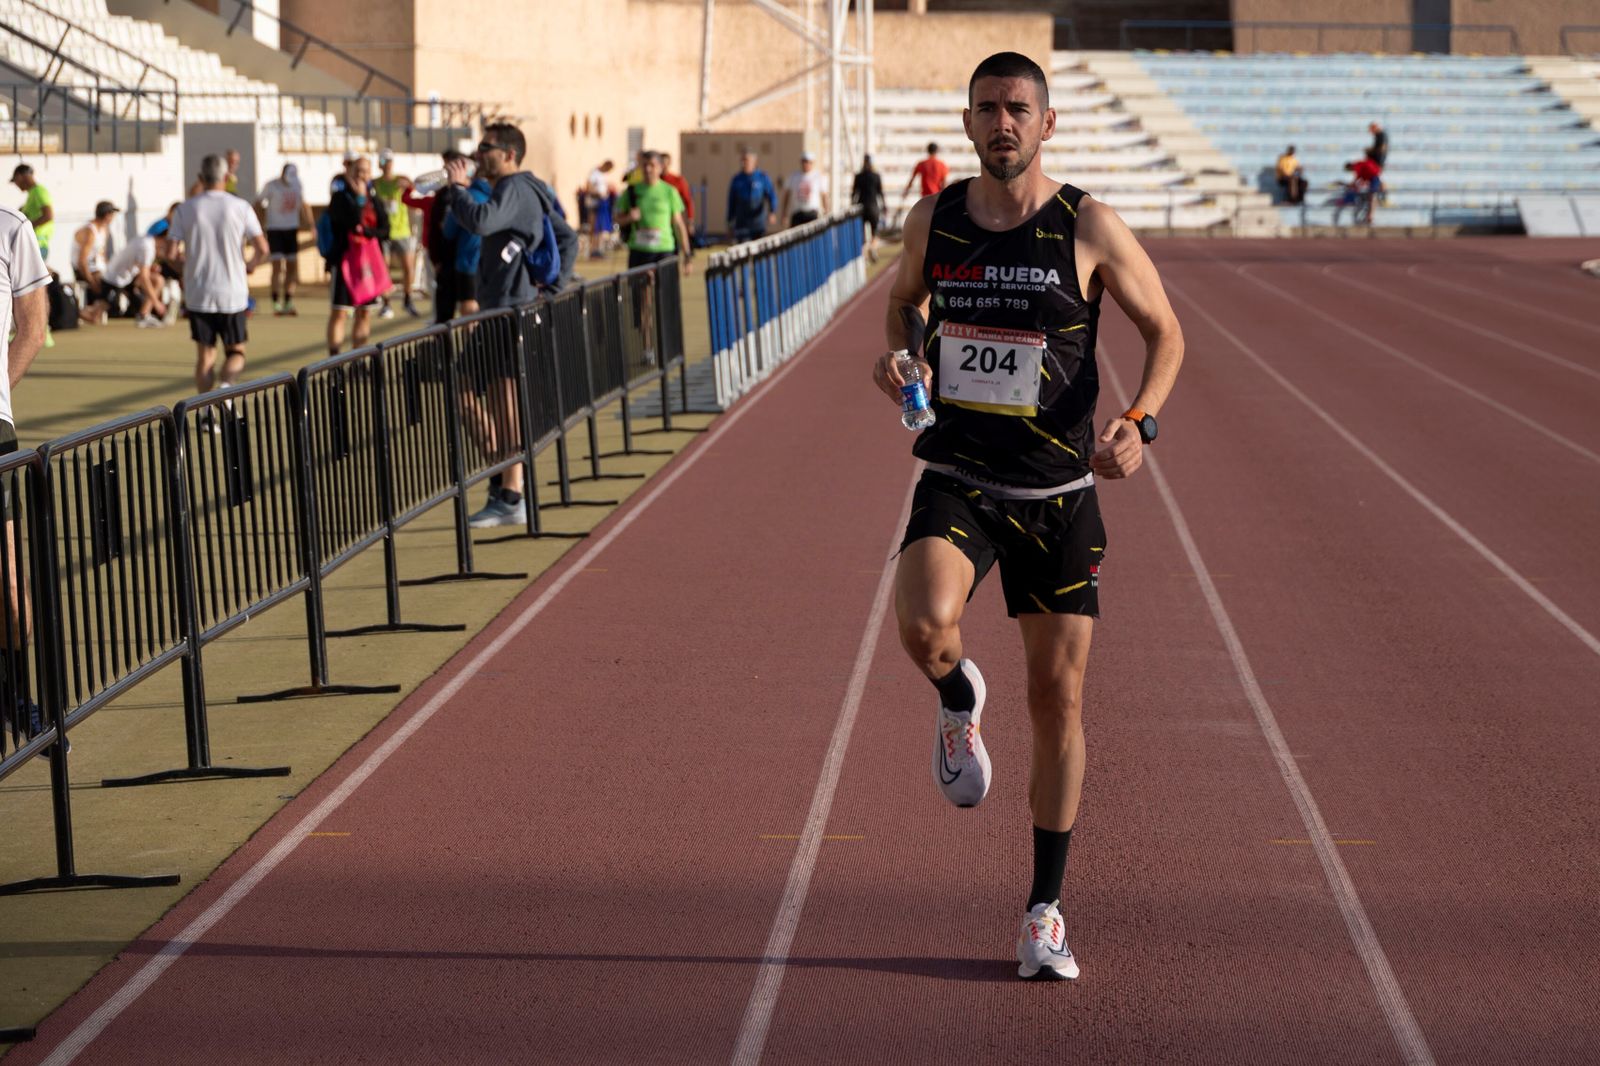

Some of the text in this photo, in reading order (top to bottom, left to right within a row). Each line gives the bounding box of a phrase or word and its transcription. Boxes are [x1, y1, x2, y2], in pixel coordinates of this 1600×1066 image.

[937, 281, 988, 289] NEUMATICOS
[1000, 282, 1046, 292] SERVICIOS
[949, 297, 1029, 310] 664 655 789
[944, 324, 977, 337] XXXVI
[959, 344, 1018, 376] 204
